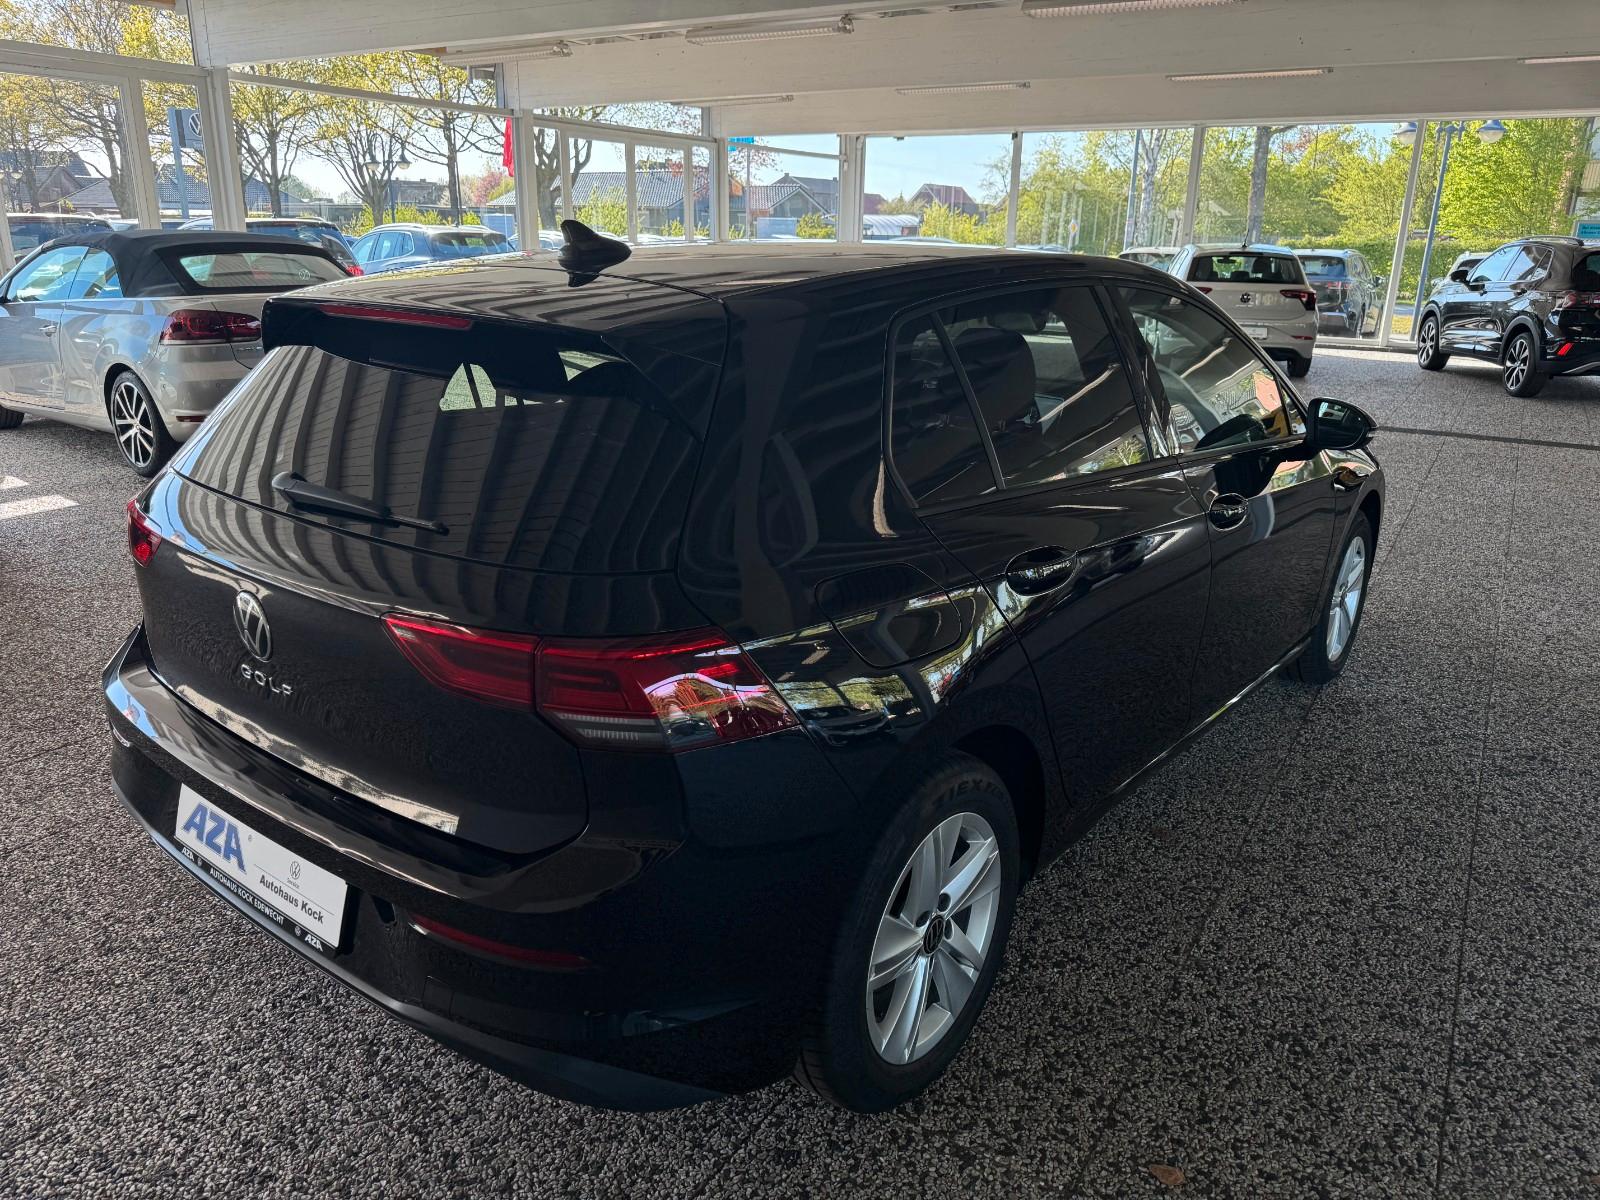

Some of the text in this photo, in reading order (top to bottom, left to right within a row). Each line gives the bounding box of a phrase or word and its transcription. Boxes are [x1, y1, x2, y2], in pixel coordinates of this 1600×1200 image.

[241, 664, 293, 696] GOLF
[182, 803, 247, 874] AZA
[181, 846, 323, 952] AZA AUTOHAUS KOCK EDEWECHT AZA
[259, 874, 324, 924] Autohaus Kock
